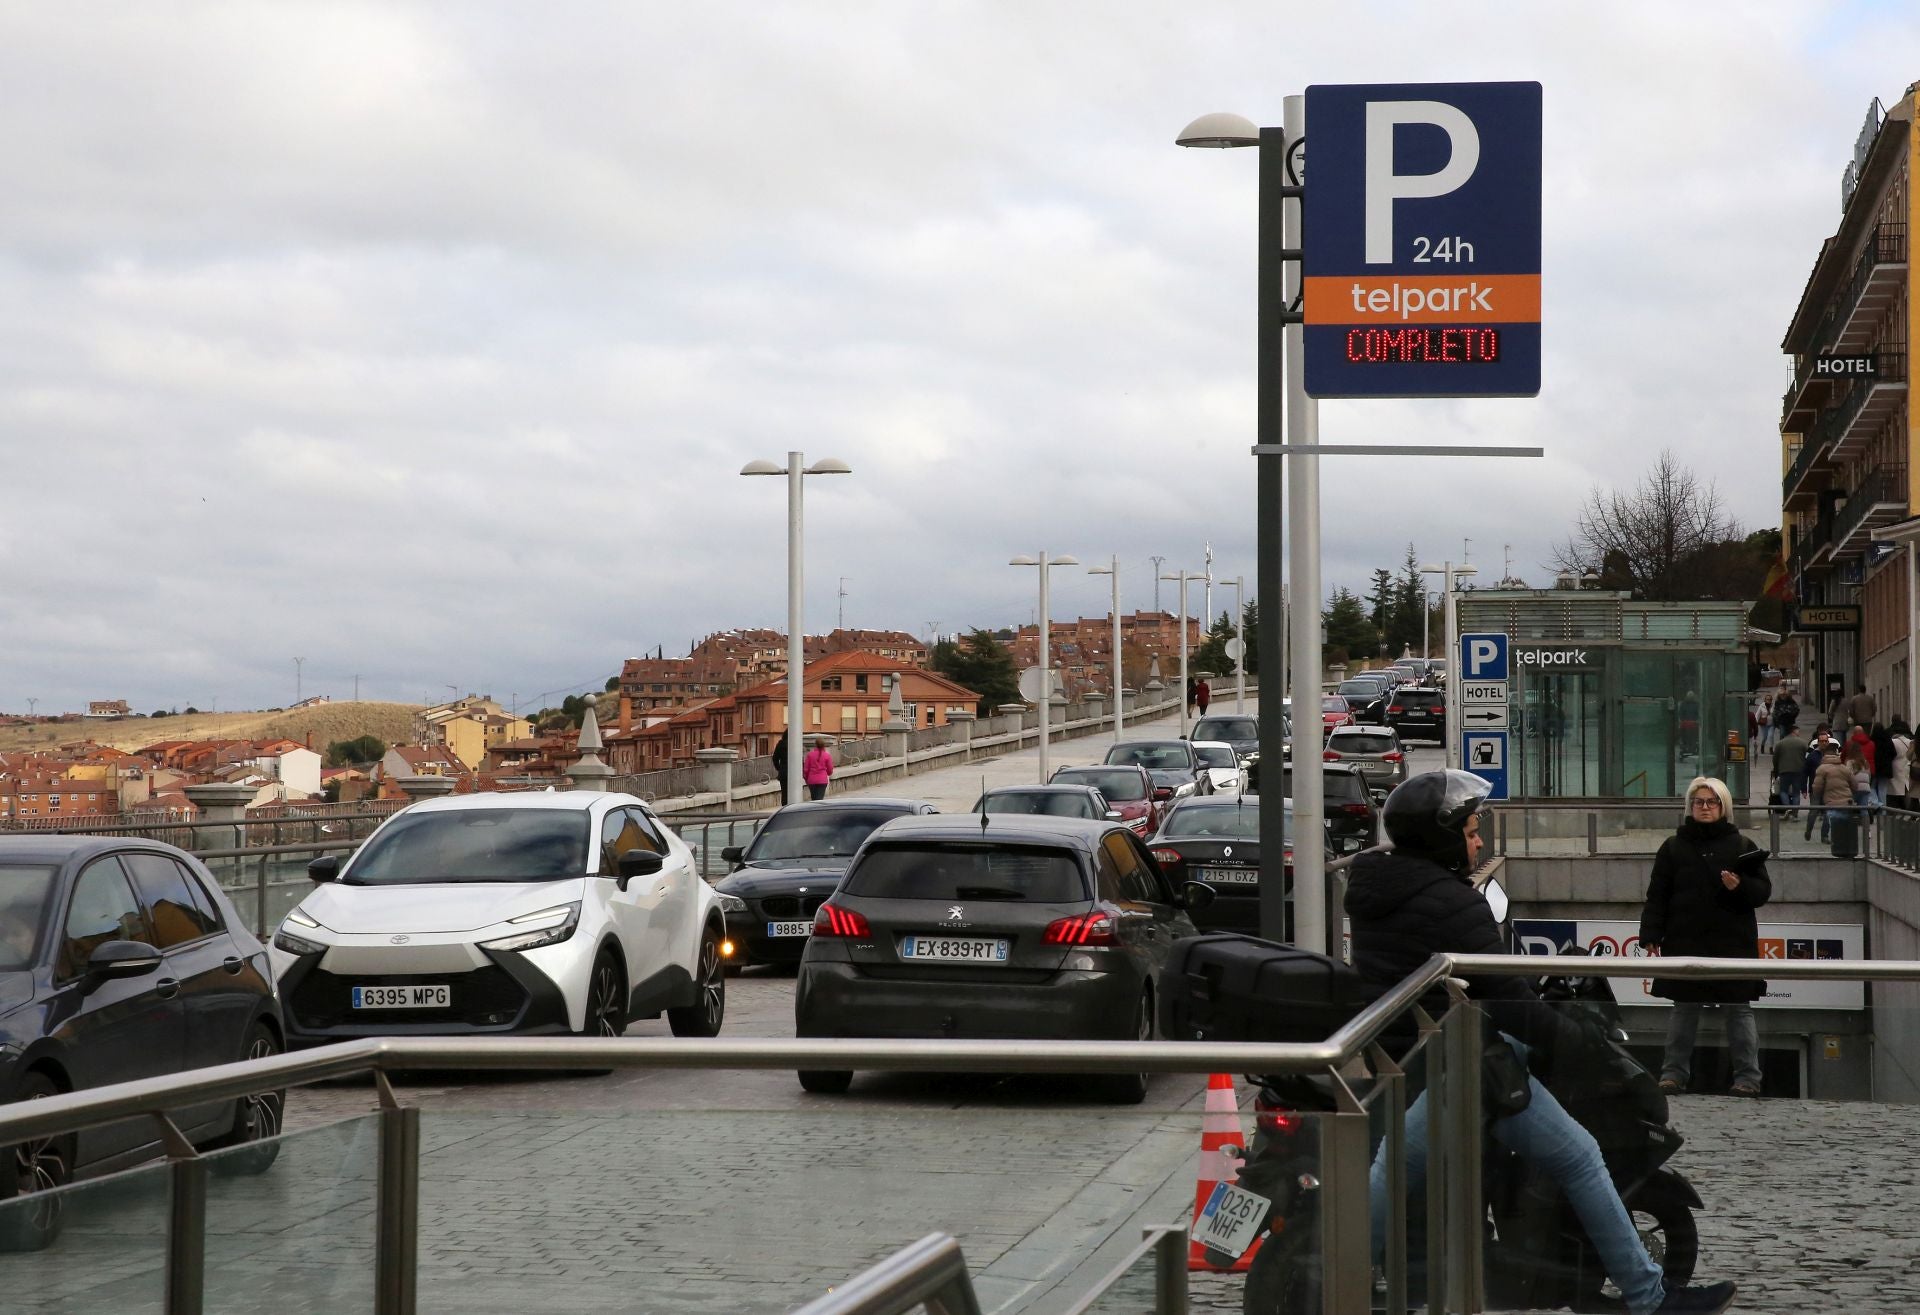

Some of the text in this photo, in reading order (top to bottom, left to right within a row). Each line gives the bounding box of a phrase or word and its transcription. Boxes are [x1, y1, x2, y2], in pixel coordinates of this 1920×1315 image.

[1365, 100, 1480, 264] P
[1413, 236, 1474, 262] 24h
[1351, 282, 1494, 319] telpark
[1347, 328, 1496, 361] COMPLETO
[1817, 359, 1874, 373] HOTEL
[1808, 611, 1849, 621] HOTEL
[1470, 640, 1498, 675] P
[1516, 649, 1587, 668] telpark
[1466, 687, 1503, 698] HOTEL
[1205, 870, 1256, 883] 2151 GXZ
[776, 923, 805, 935] 9885
[364, 988, 446, 1005] 6395 MPG
[1220, 1190, 1264, 1222] 0261
[1207, 1212, 1243, 1240] NHF
